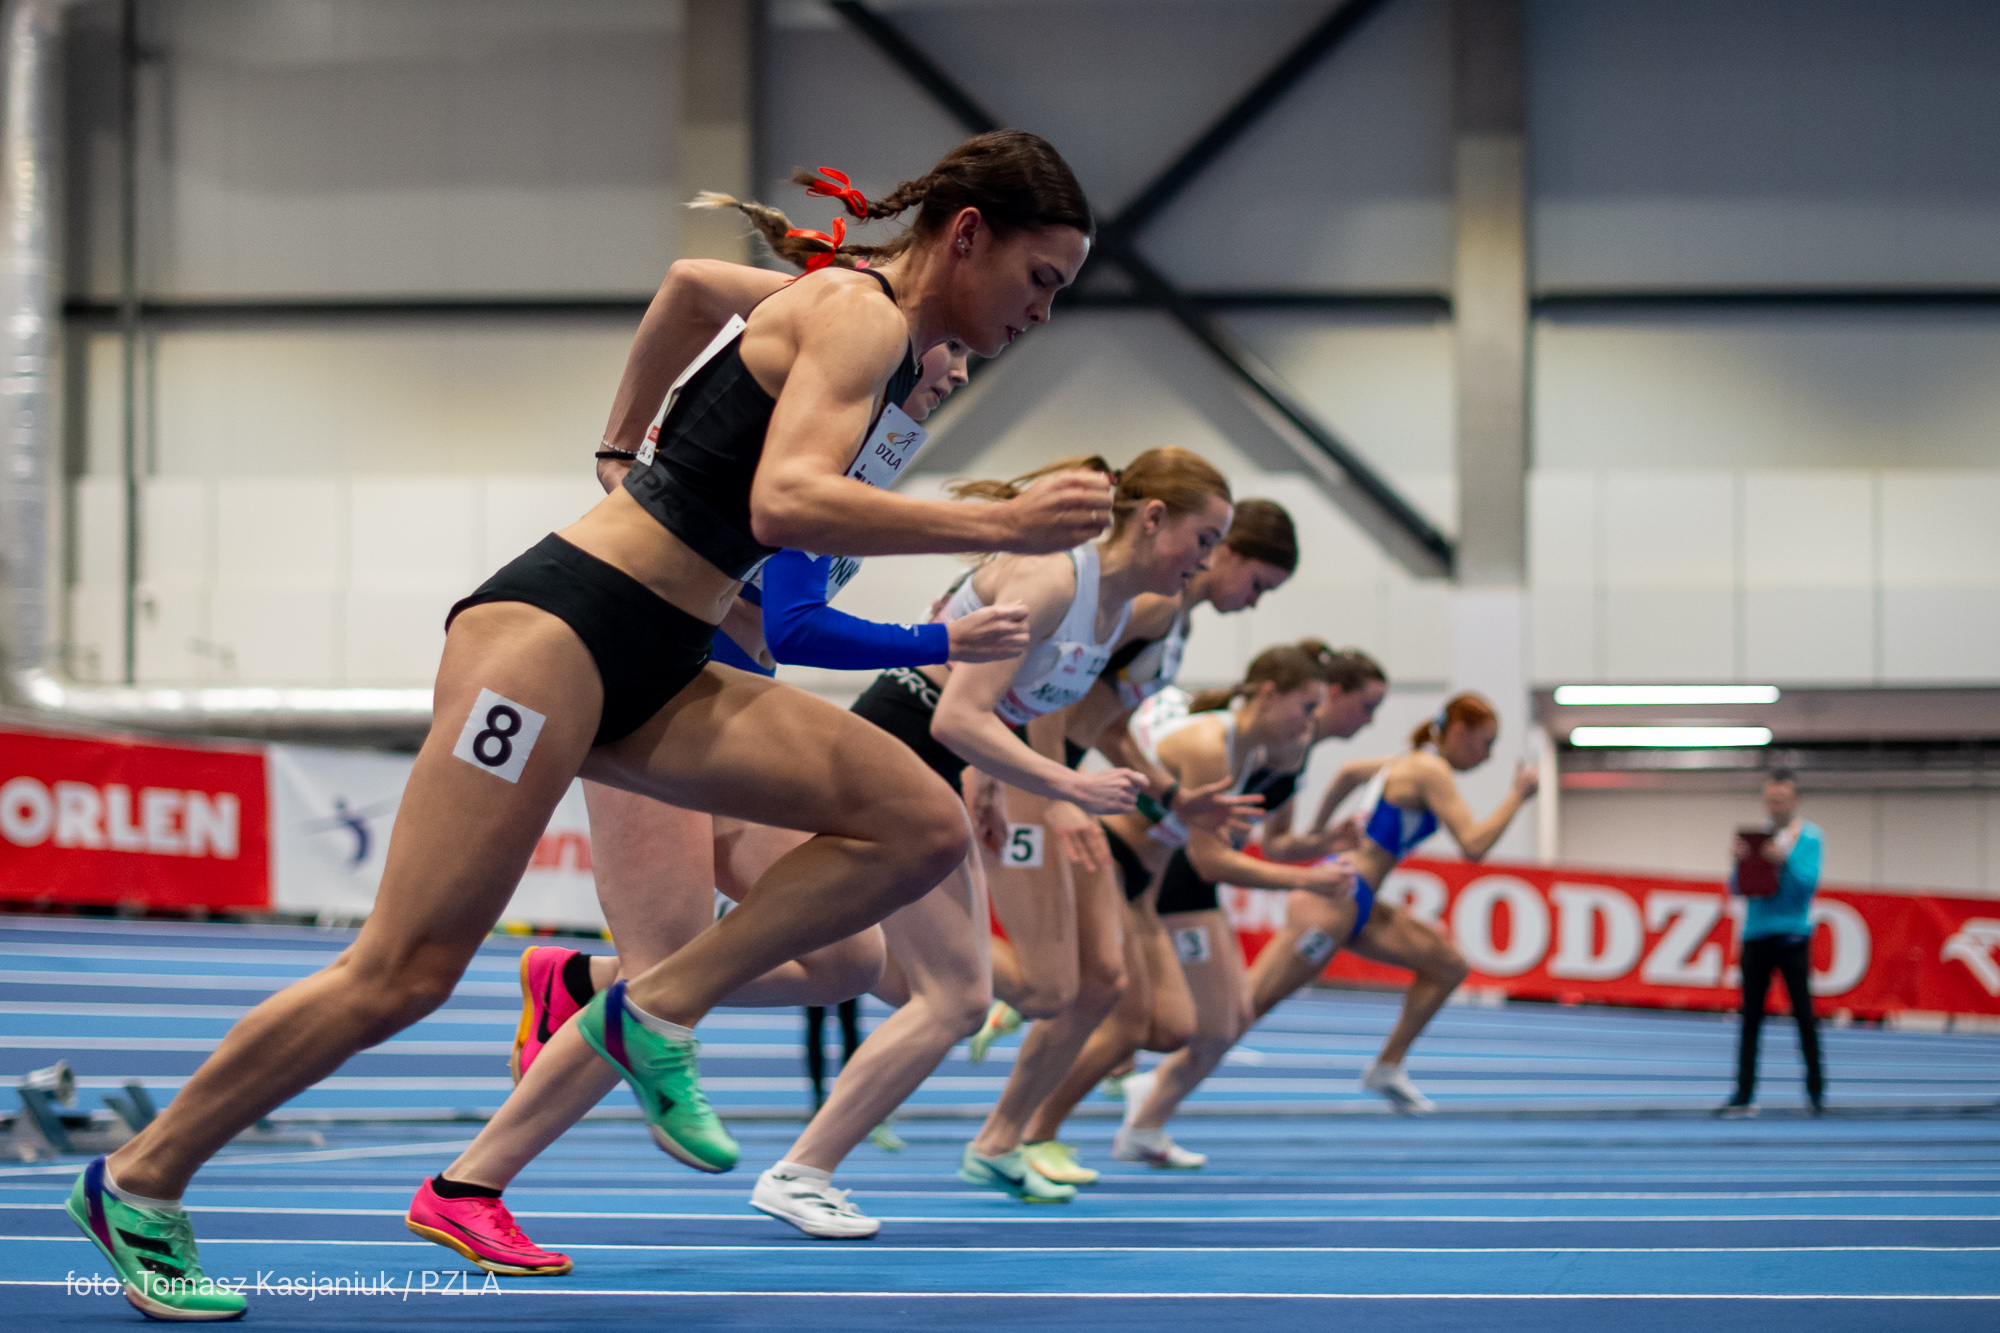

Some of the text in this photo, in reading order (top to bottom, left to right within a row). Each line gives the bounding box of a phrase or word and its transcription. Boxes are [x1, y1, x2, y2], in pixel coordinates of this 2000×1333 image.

[874, 442, 903, 471] DZLA
[472, 704, 523, 768] 8
[0, 774, 242, 860] ORLEN
[1011, 828, 1034, 863] 5
[1375, 867, 1872, 997] ODZO
